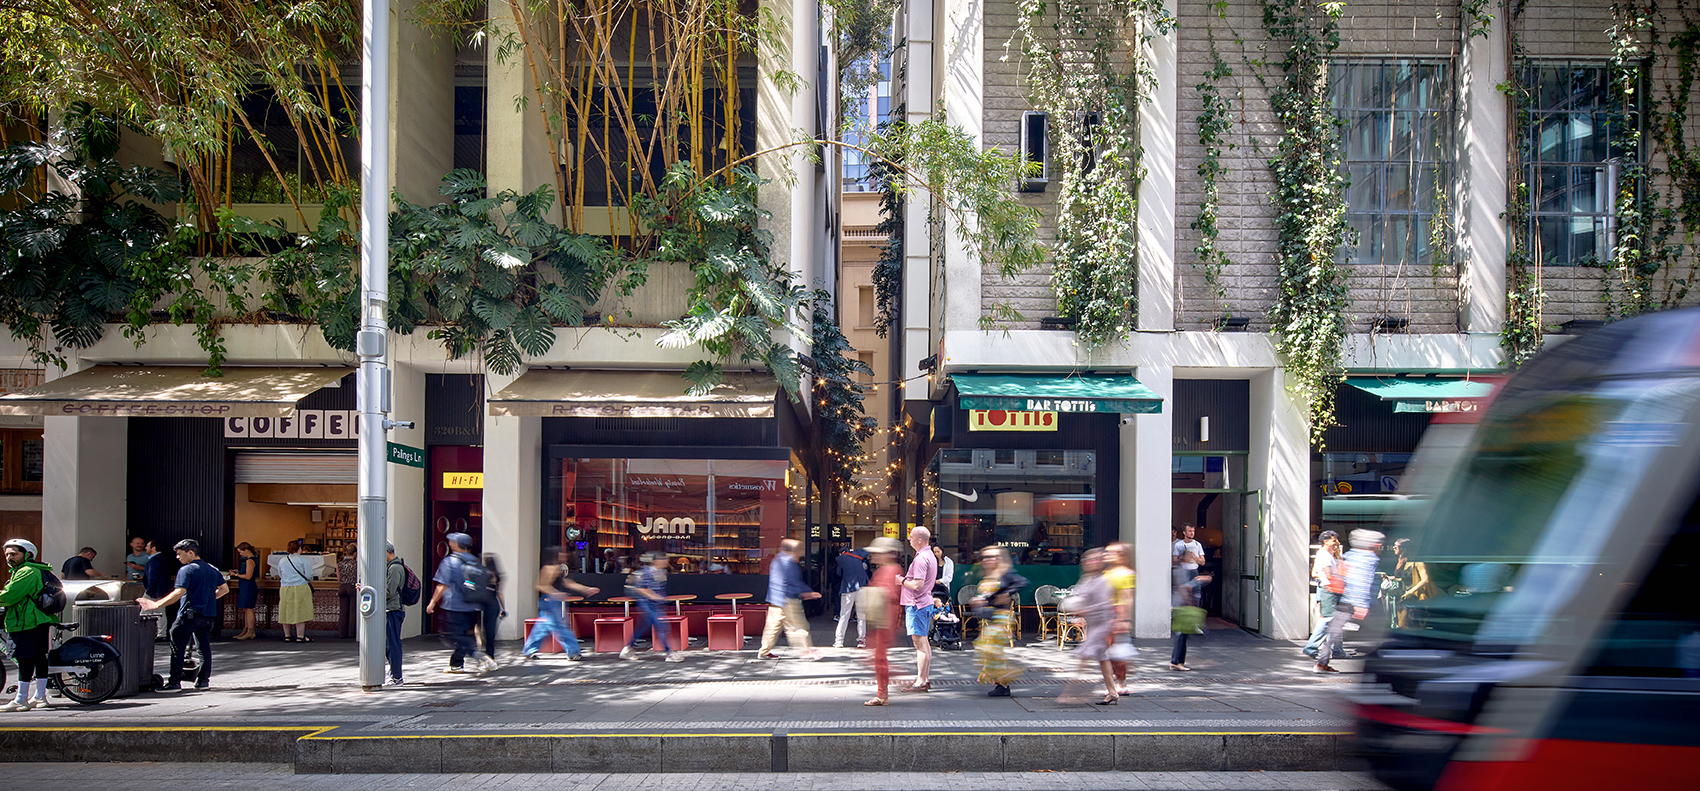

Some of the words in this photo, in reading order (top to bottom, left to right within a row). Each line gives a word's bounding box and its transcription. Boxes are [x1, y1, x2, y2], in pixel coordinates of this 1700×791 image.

[1026, 399, 1051, 410] BAR
[1425, 400, 1449, 412] BAR
[228, 414, 359, 435] COFFE
[393, 447, 413, 463] Palings
[414, 452, 422, 463] Ln
[451, 476, 479, 485] HI-FI
[636, 517, 696, 534] JAM
